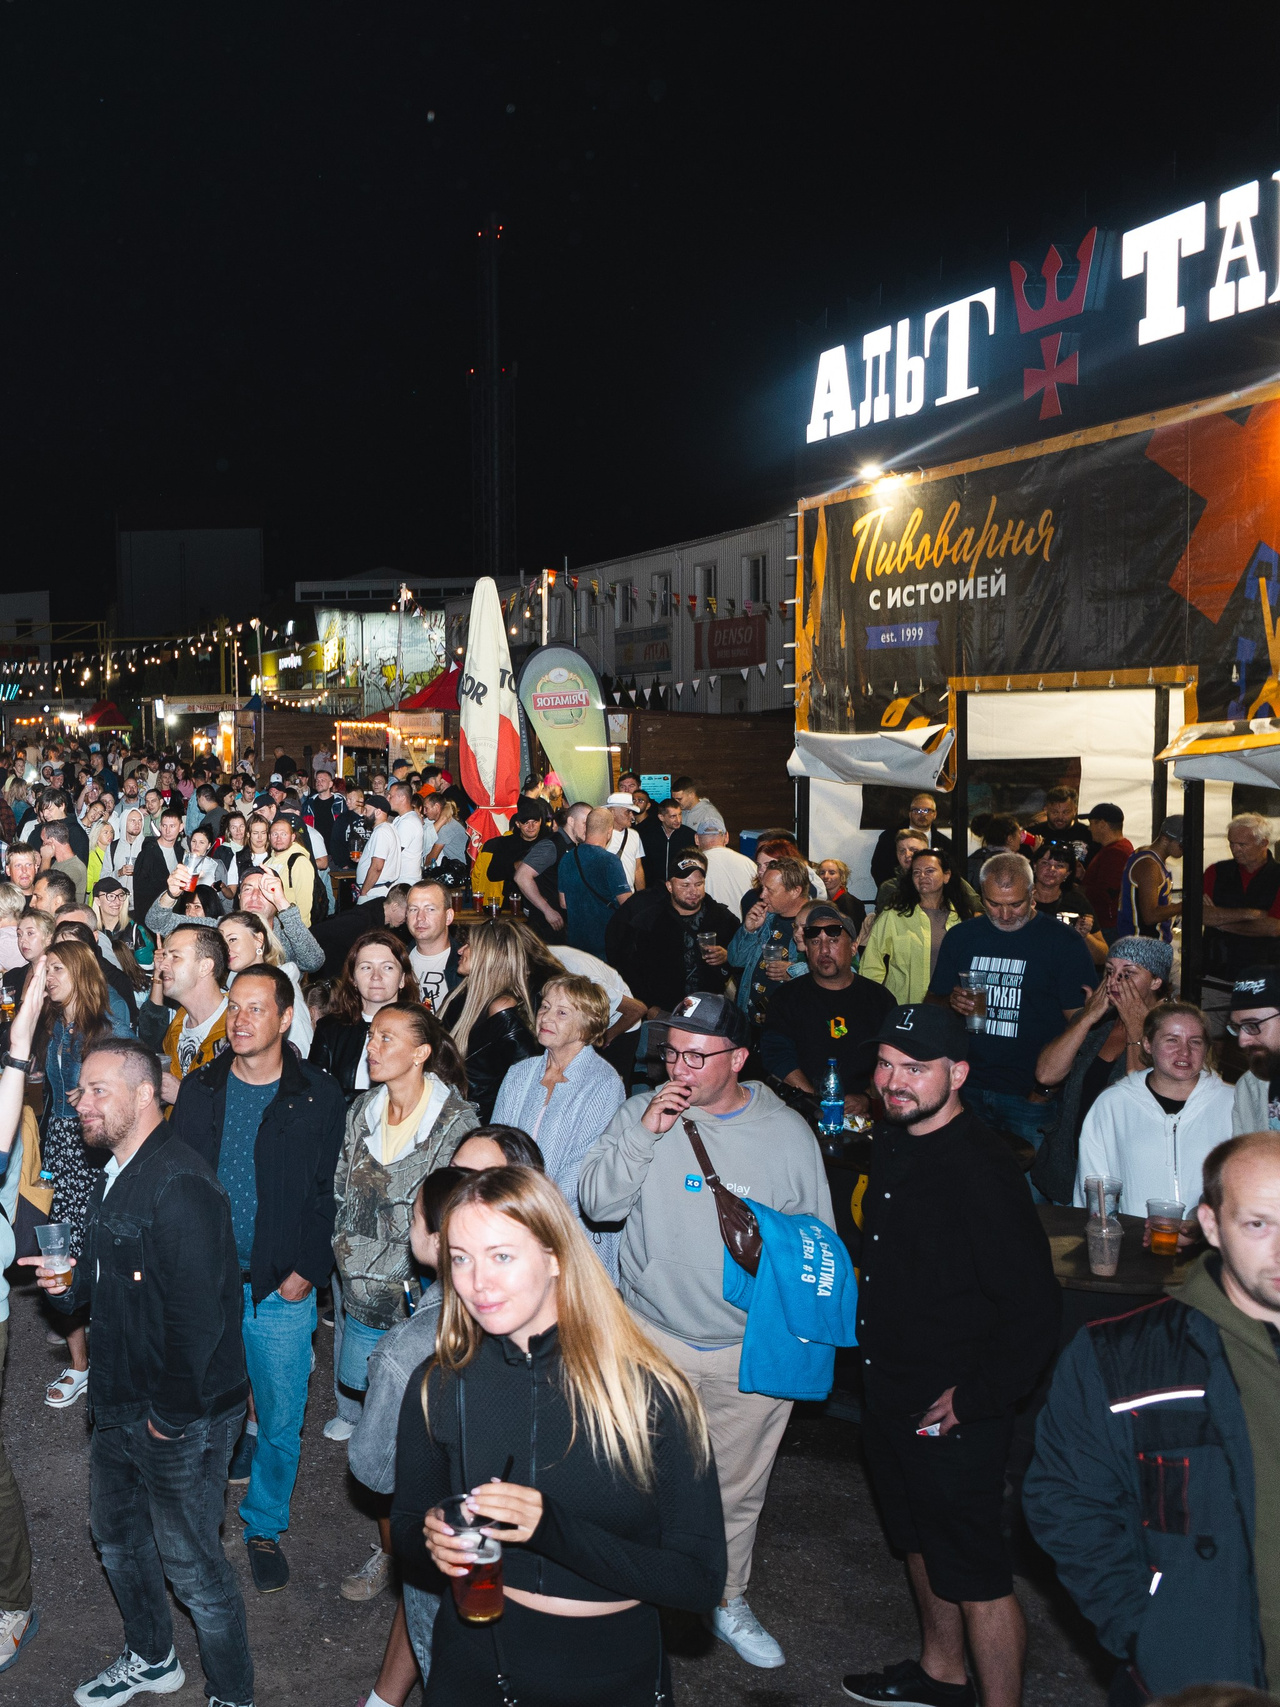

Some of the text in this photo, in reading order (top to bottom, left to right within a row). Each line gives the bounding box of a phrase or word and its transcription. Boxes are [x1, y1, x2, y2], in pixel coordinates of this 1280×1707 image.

[806, 170, 1280, 444] АЛЬТ ТА
[850, 495, 1055, 584] Пивоварня
[869, 568, 1007, 610] С ИСТОРИЕЙ
[714, 626, 753, 647] DENSO
[880, 626, 924, 643] est. 1999
[726, 1183, 751, 1196] Play
[817, 1241, 836, 1296] БАЛТИКА
